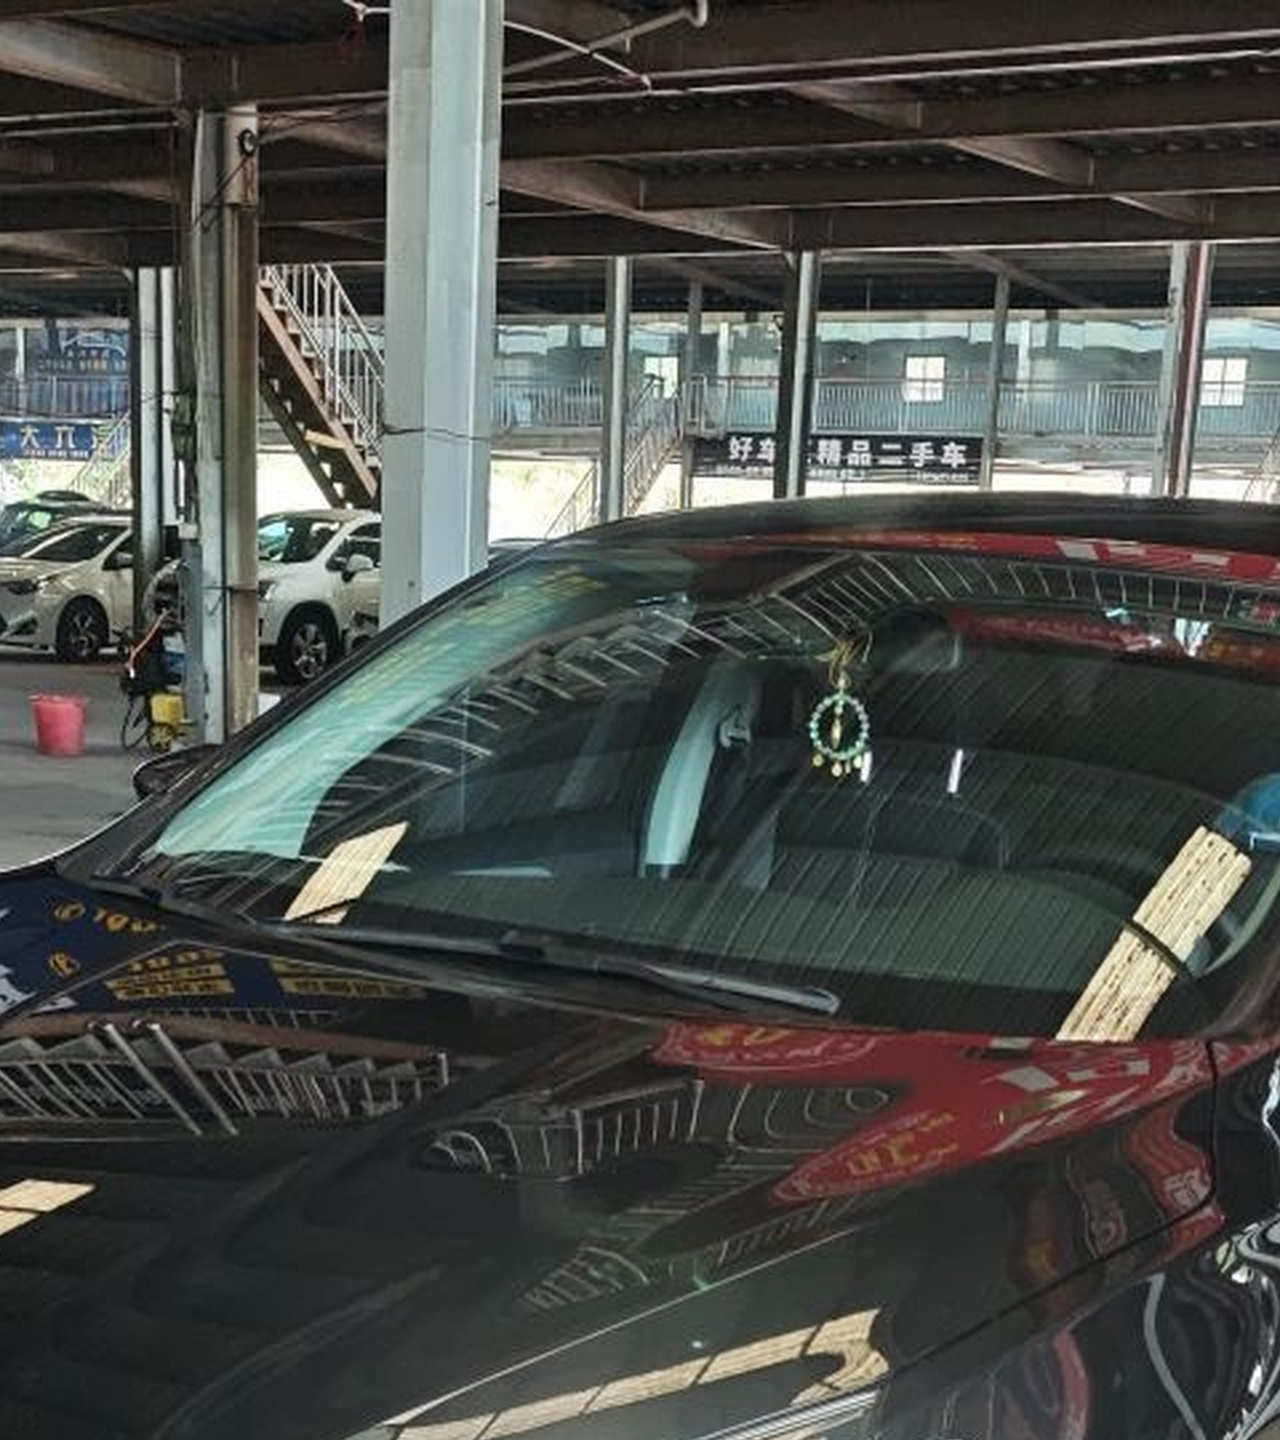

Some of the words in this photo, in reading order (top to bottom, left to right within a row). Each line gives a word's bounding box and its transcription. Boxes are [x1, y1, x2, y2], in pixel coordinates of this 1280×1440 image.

[729, 436, 967, 468] 好车精品二手车
